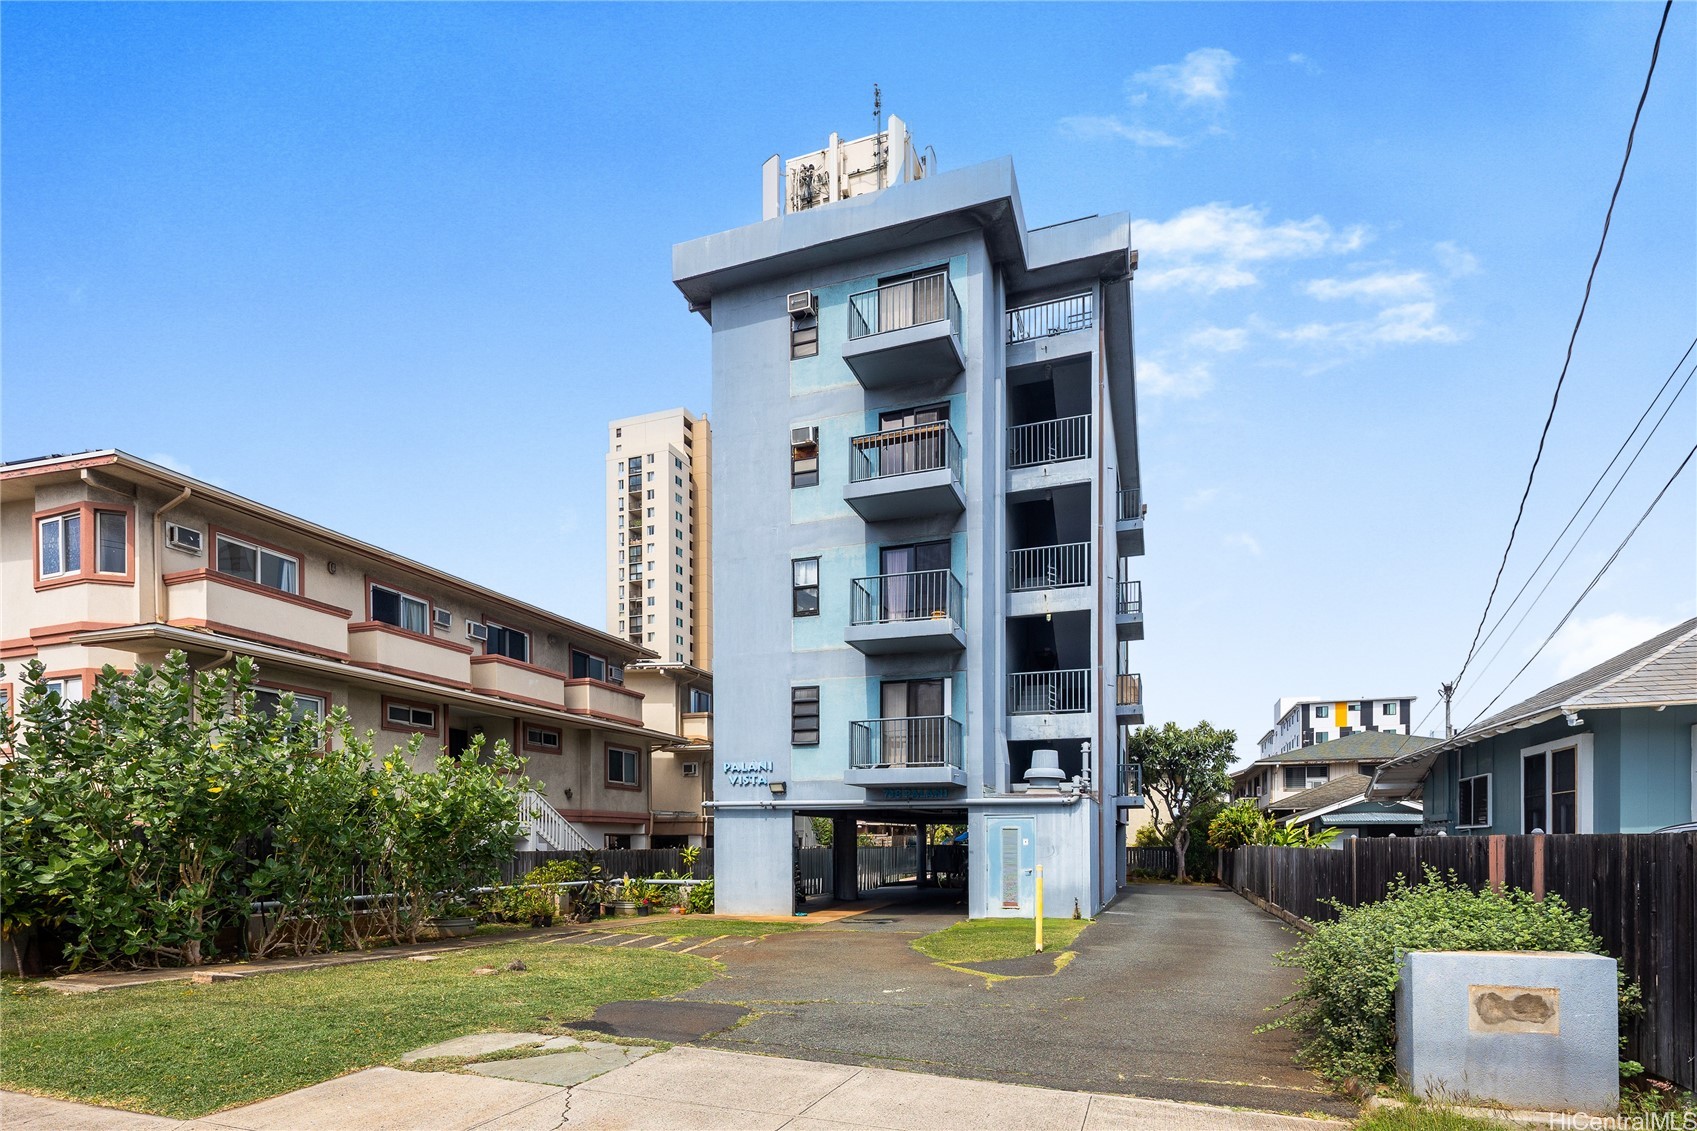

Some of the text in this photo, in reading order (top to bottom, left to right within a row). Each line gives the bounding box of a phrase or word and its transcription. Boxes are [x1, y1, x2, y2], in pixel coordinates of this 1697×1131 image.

[723, 761, 774, 775] PALANI
[729, 775, 768, 787] VISTA
[903, 788, 949, 799] PALANI
